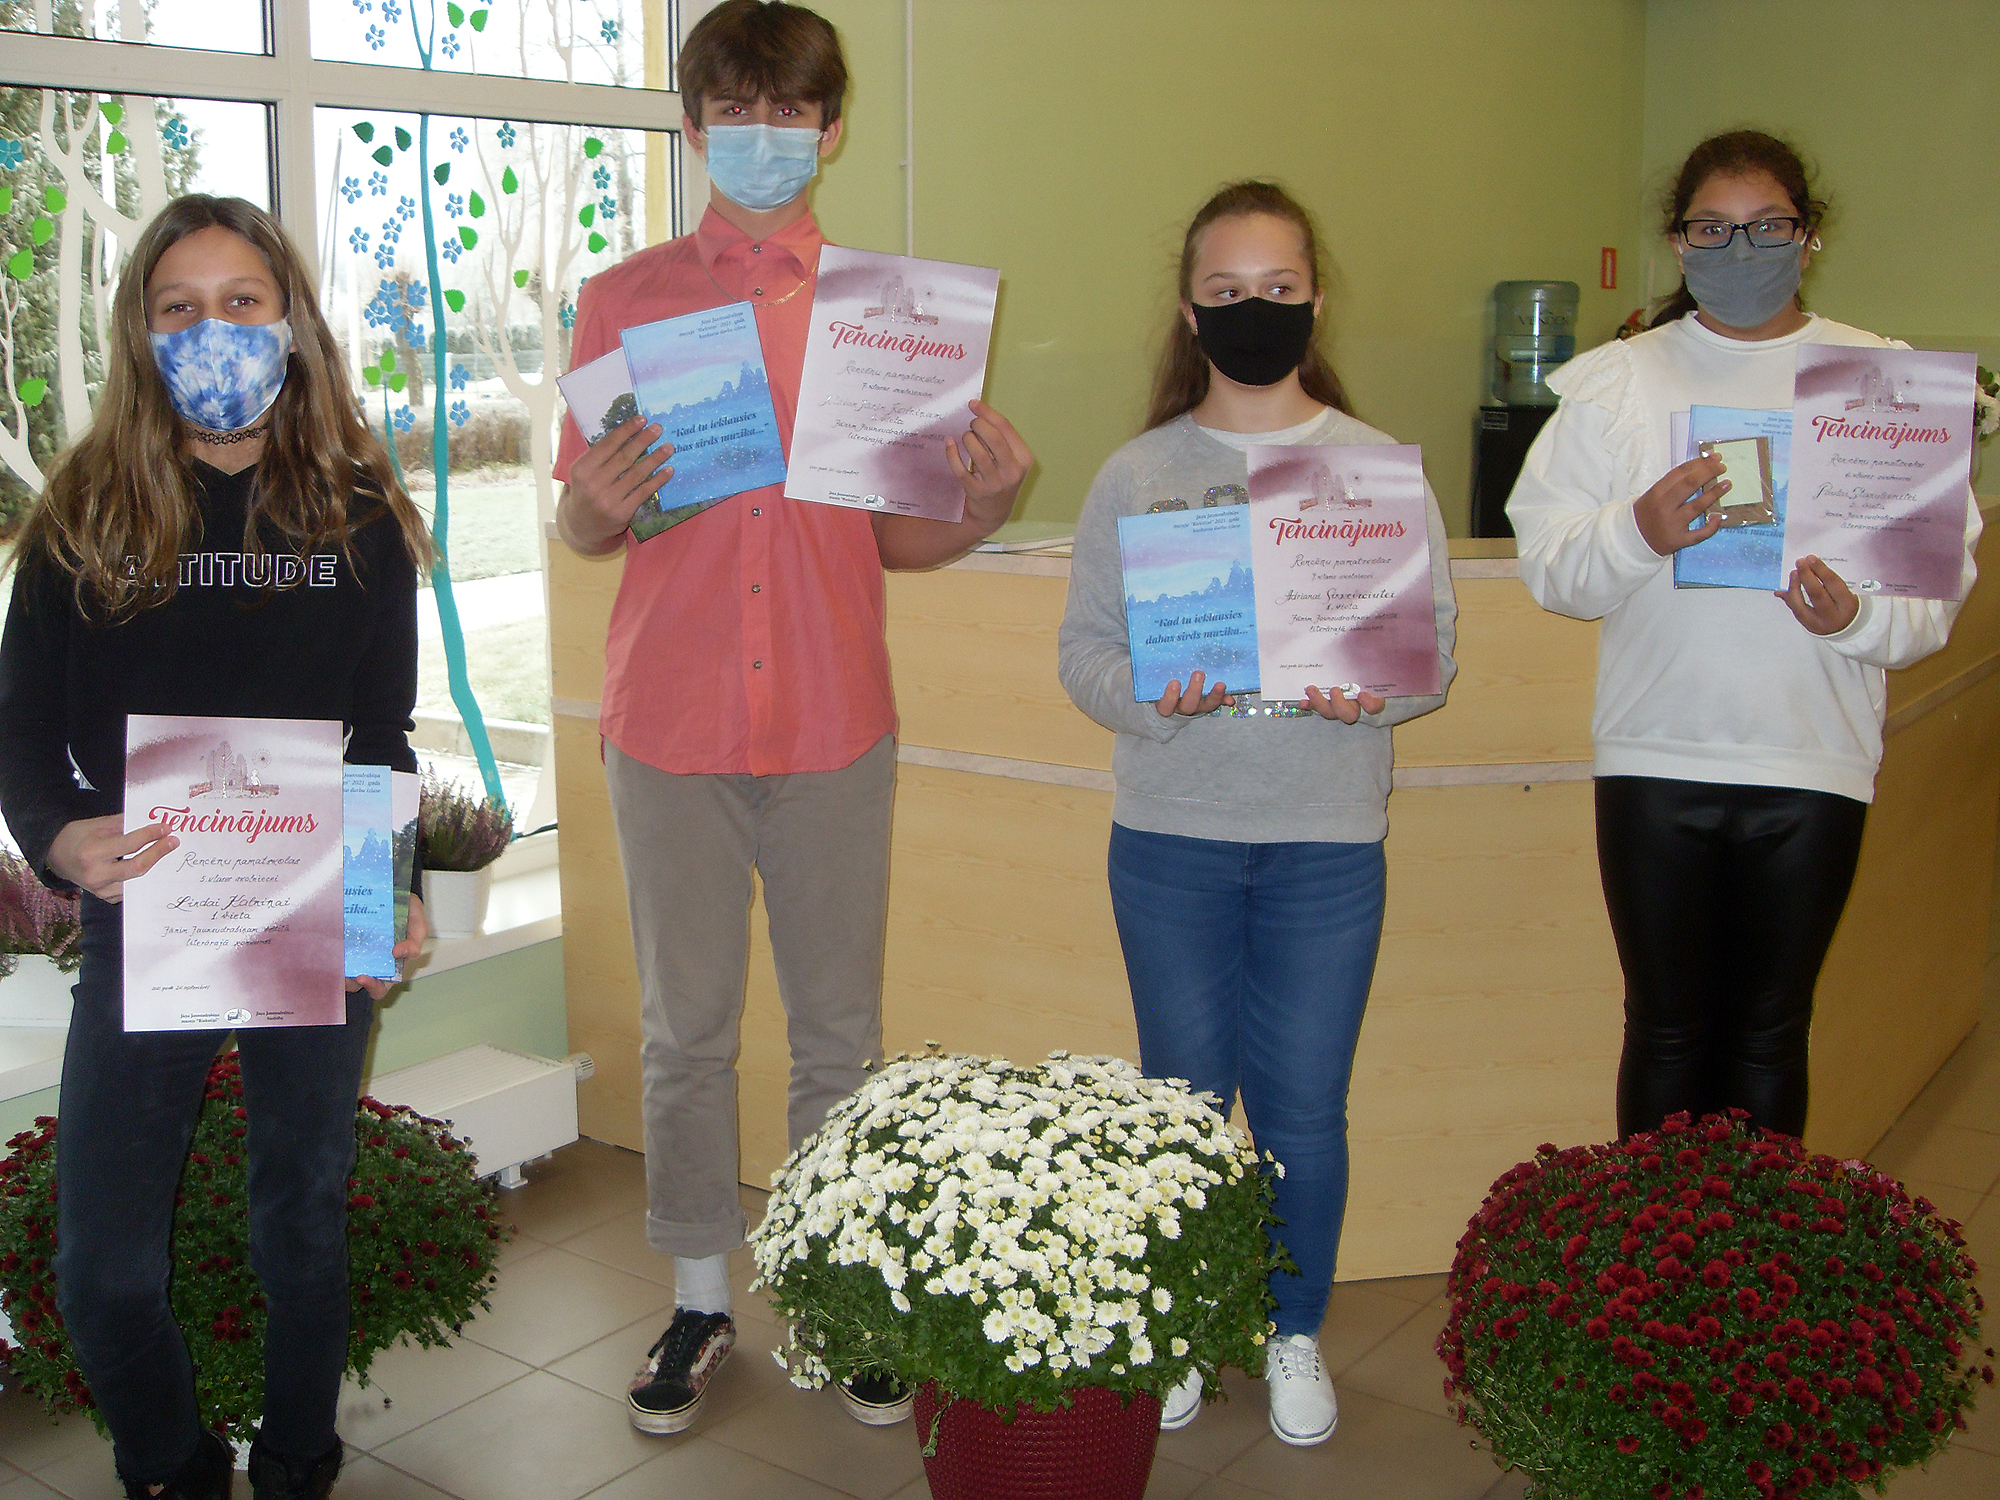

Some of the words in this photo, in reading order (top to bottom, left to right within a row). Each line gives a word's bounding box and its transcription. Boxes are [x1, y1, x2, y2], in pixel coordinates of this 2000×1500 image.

[828, 320, 967, 362] Tencinājums
[698, 423, 708, 432] tu
[710, 411, 757, 429] ieklausies
[1811, 415, 1952, 449] Tencinājums
[695, 435, 718, 448] sirds
[1269, 517, 1407, 547] Tencinājums
[1182, 616, 1192, 625] tu
[1194, 610, 1243, 624] ieklausies
[1145, 634, 1174, 645] dabas
[1176, 630, 1201, 642] sirds
